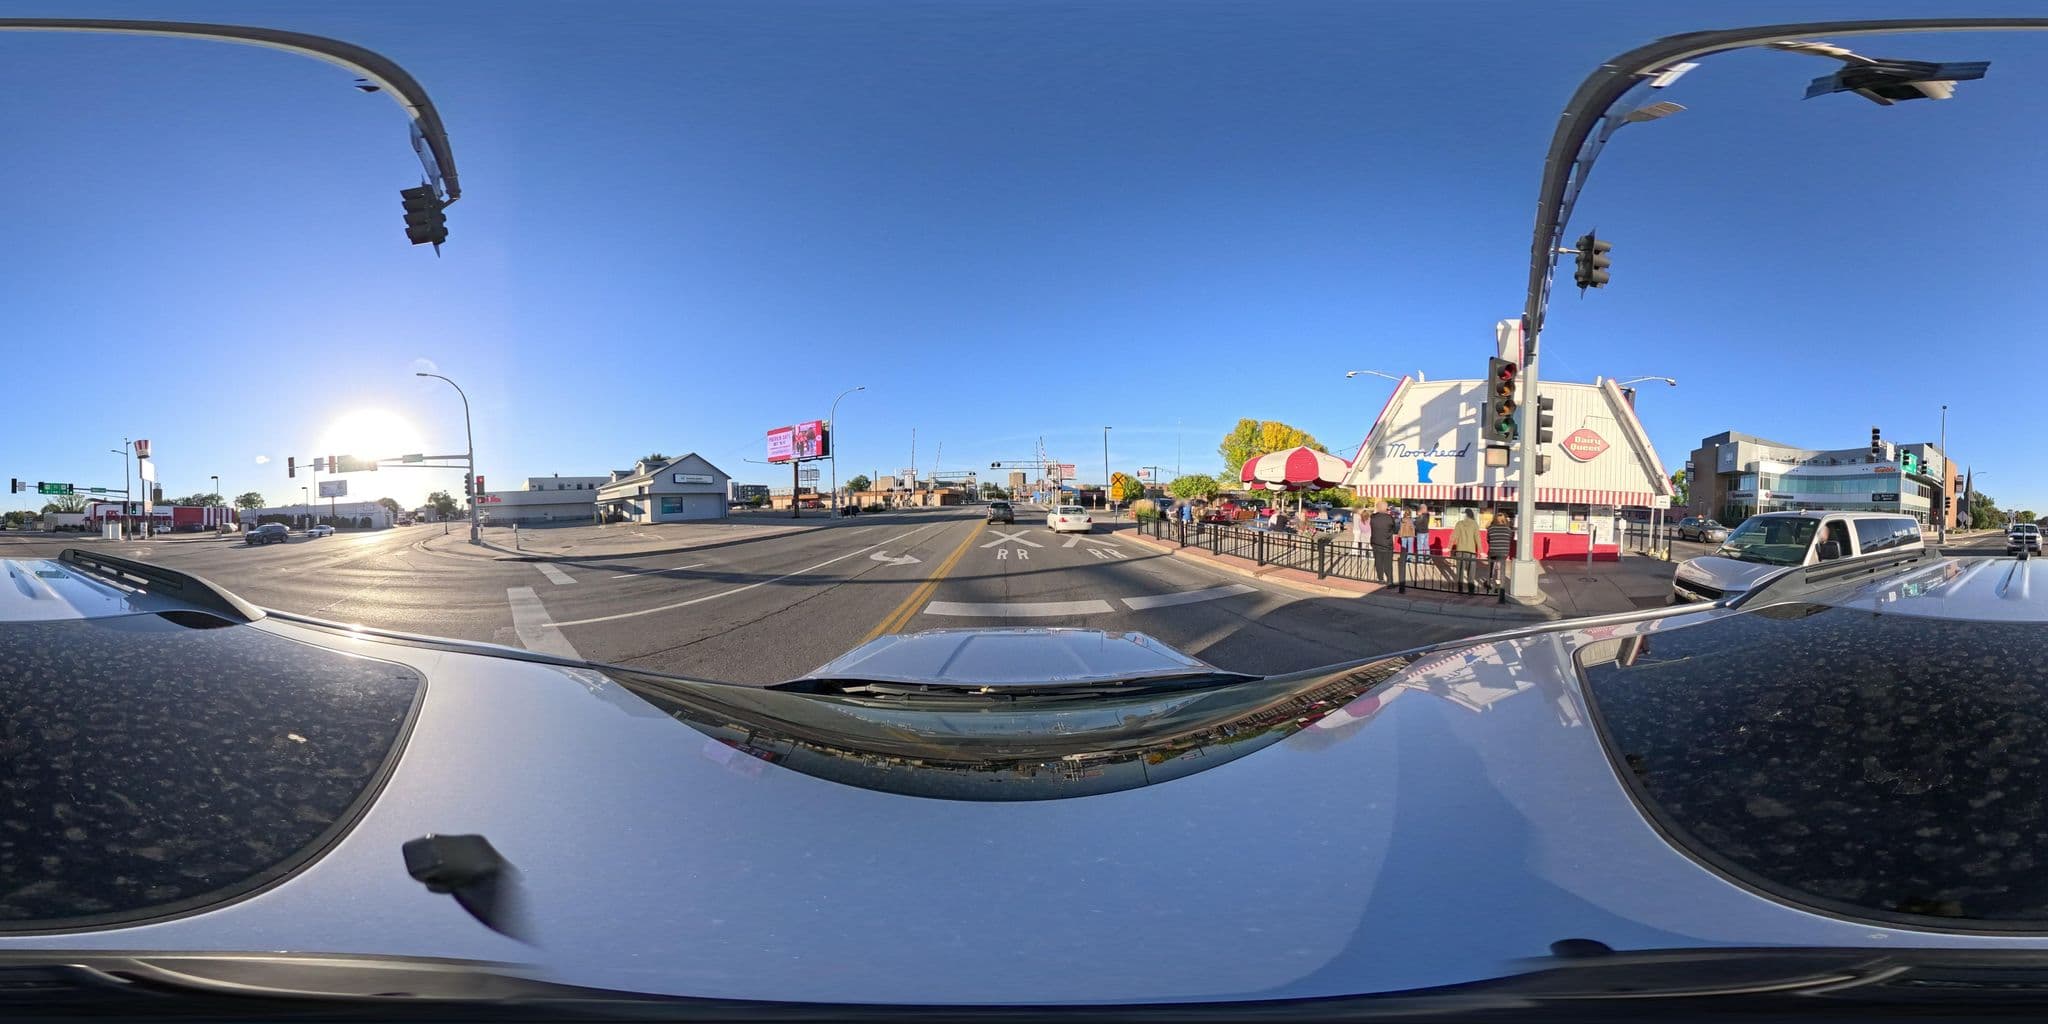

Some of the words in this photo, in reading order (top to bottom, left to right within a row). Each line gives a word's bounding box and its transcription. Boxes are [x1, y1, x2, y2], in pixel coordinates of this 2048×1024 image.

[1575, 436, 1600, 444] Dairy
[1387, 442, 1471, 458] Moorhead
[1570, 443, 1600, 452] Queen
